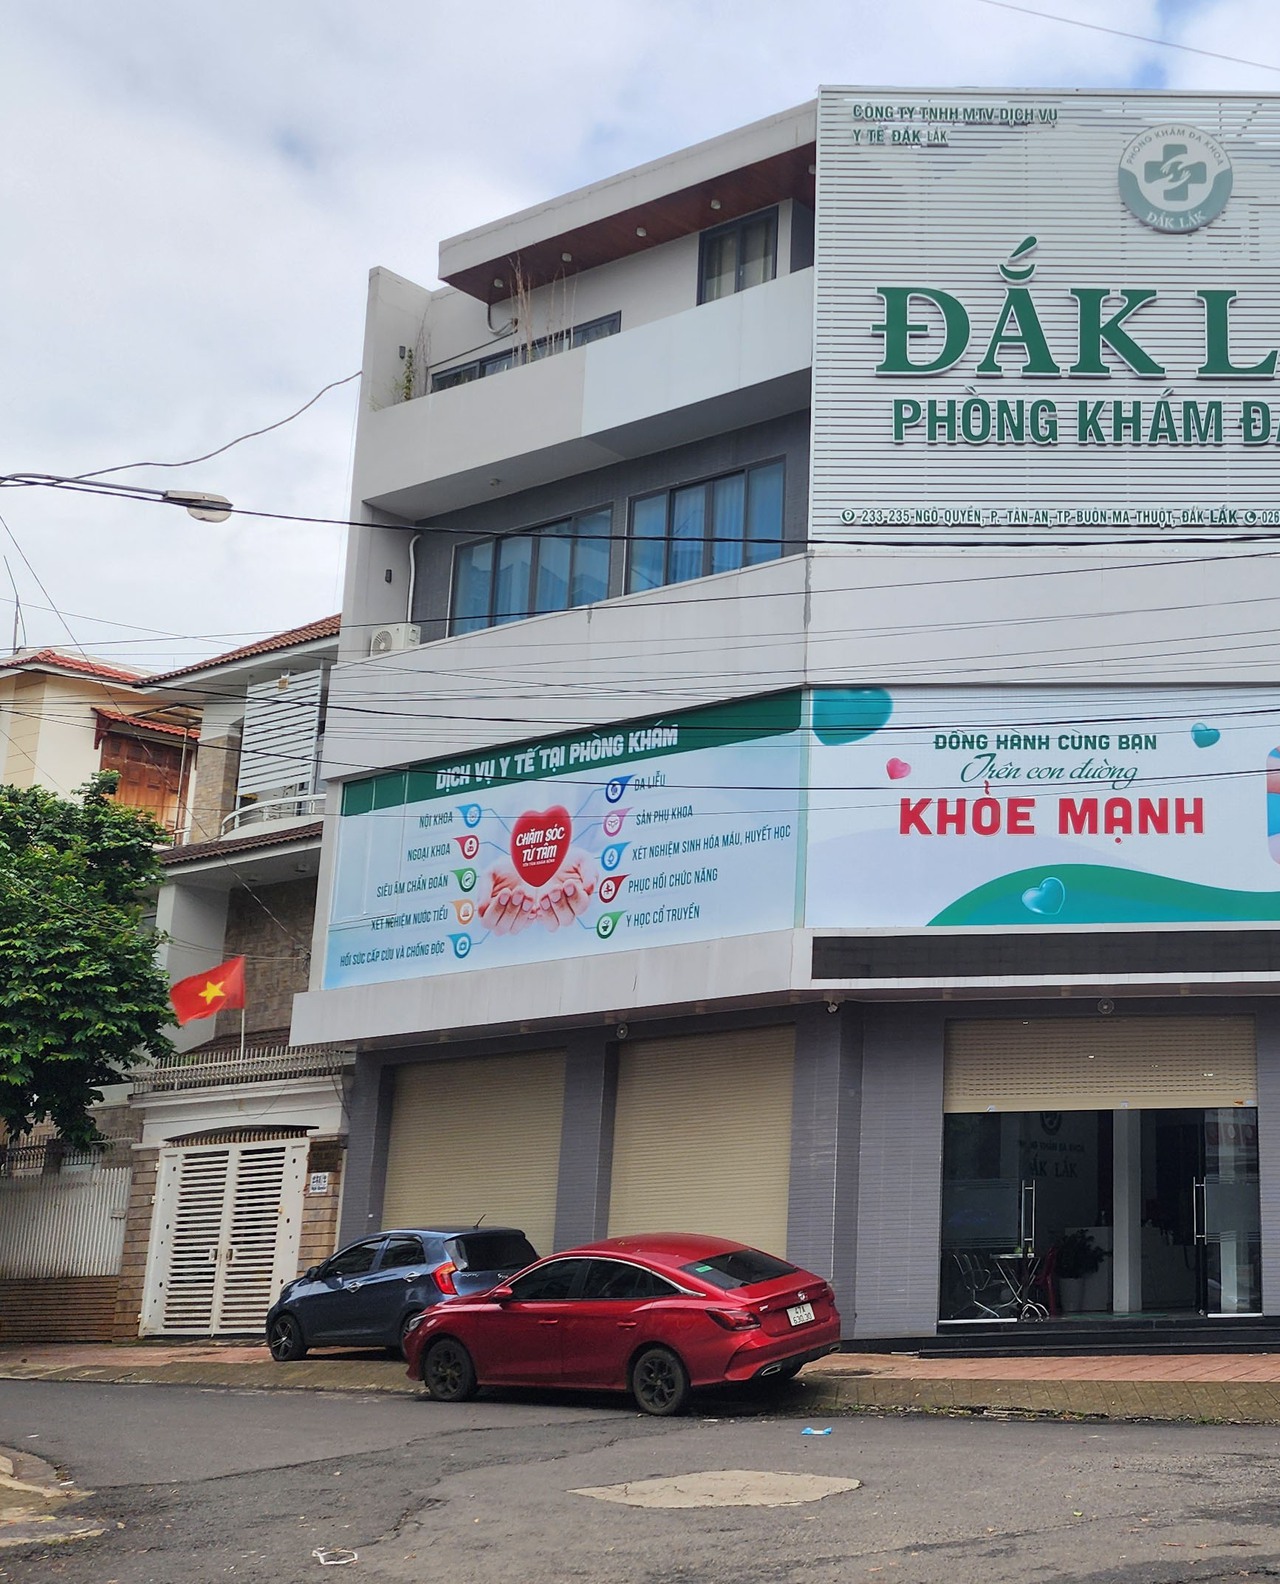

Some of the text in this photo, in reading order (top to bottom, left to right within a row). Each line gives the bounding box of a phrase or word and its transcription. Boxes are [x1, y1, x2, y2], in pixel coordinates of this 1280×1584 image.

[853, 103, 893, 119] CÔNG
[898, 106, 915, 119] TY
[920, 107, 958, 120] TNHH
[963, 107, 994, 120] MTV
[1000, 107, 1034, 126] DỊCH
[853, 129, 862, 142] Y
[1154, 127, 1186, 140] KHÁM
[1204, 140, 1225, 167] KHOA
[1146, 210, 1206, 229] ĐẮK LẮK
[871, 235, 1166, 378] ĐẮK
[893, 385, 1059, 446] PHÒNG
[1077, 387, 1224, 446] KHÁM
[915, 507, 938, 522] NGÔ
[990, 510, 1000, 523] P.
[1076, 507, 1107, 523] BUÔN
[1112, 510, 1130, 523] MA
[1182, 504, 1205, 523] ĐẮK
[1209, 504, 1238, 523] LẮK
[933, 728, 1157, 754] ĐỒNG HÀNH CÙNG BẠN
[435, 720, 679, 792] DỊCH VỤ Y TẾ TẠI PHÒNG KHÁM
[960, 752, 1138, 790] Trên con đường
[418, 811, 453, 830] NỘI KHOA
[635, 805, 694, 826] SẢN PHỤ KHOA
[899, 780, 1205, 845] KHỎE MẠNH
[515, 823, 566, 847] CHĂM SÓC
[632, 845, 648, 861] XÉT
[648, 842, 680, 859] NGHIỆM
[681, 838, 701, 854] SINH
[702, 834, 720, 850] HÓA
[744, 824, 772, 844] HUYẾT
[773, 824, 791, 842] HỌC
[407, 843, 451, 862] NGOẠI KHOA
[536, 842, 558, 860] TÂM
[376, 882, 393, 898] SIÊU
[394, 880, 405, 895] ÂM
[406, 874, 427, 893] CHẨN
[628, 867, 718, 894] PHỤC HỒI CHỨC NĂNG
[412, 909, 432, 926] NƯỚC
[633, 911, 651, 929] HỌC
[652, 905, 666, 924] CỔ
[666, 901, 700, 922] TRUYỀN
[395, 944, 405, 959] VÀ
